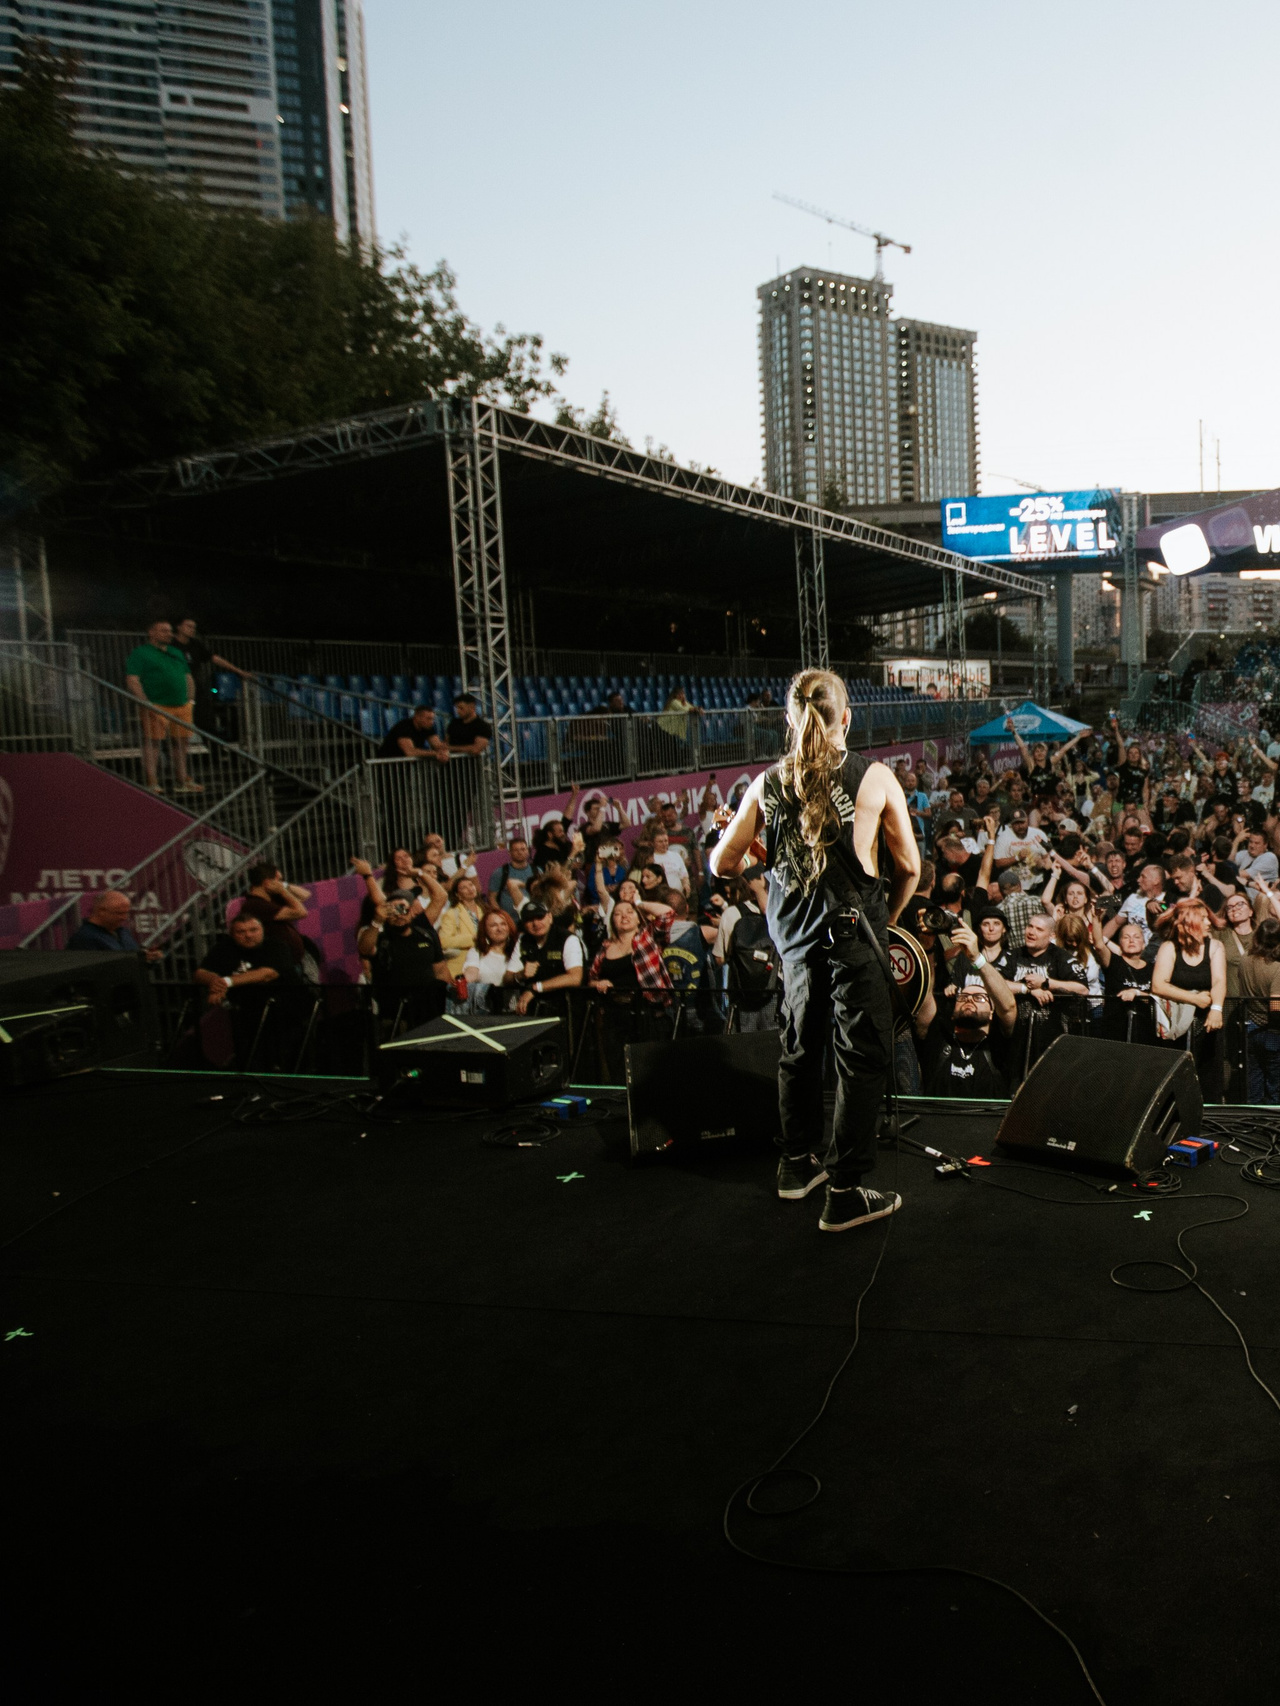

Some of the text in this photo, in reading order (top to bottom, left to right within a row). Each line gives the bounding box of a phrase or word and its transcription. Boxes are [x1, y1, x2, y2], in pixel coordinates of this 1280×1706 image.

[1009, 496, 1065, 522] -25%
[1009, 521, 1117, 553] LEVEL
[37, 869, 131, 889] ЛЕТО
